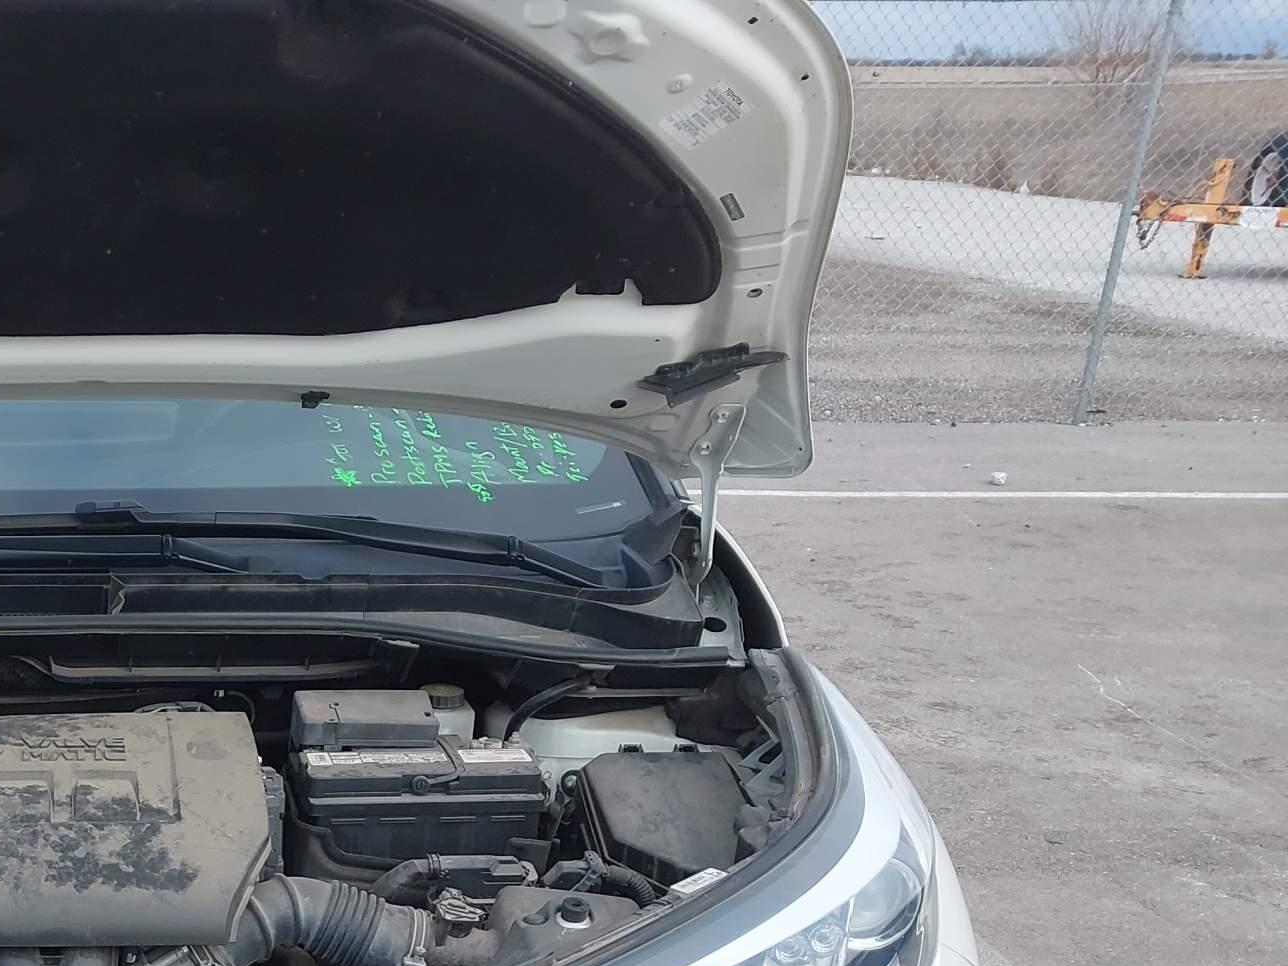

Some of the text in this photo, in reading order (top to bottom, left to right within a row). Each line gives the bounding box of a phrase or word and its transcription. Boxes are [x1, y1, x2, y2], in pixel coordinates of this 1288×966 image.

[724, 87, 745, 106] TOYOTA
[431, 445, 463, 489] TPMS
[464, 441, 502, 486] Align
[20, 737, 126, 749] VALVE
